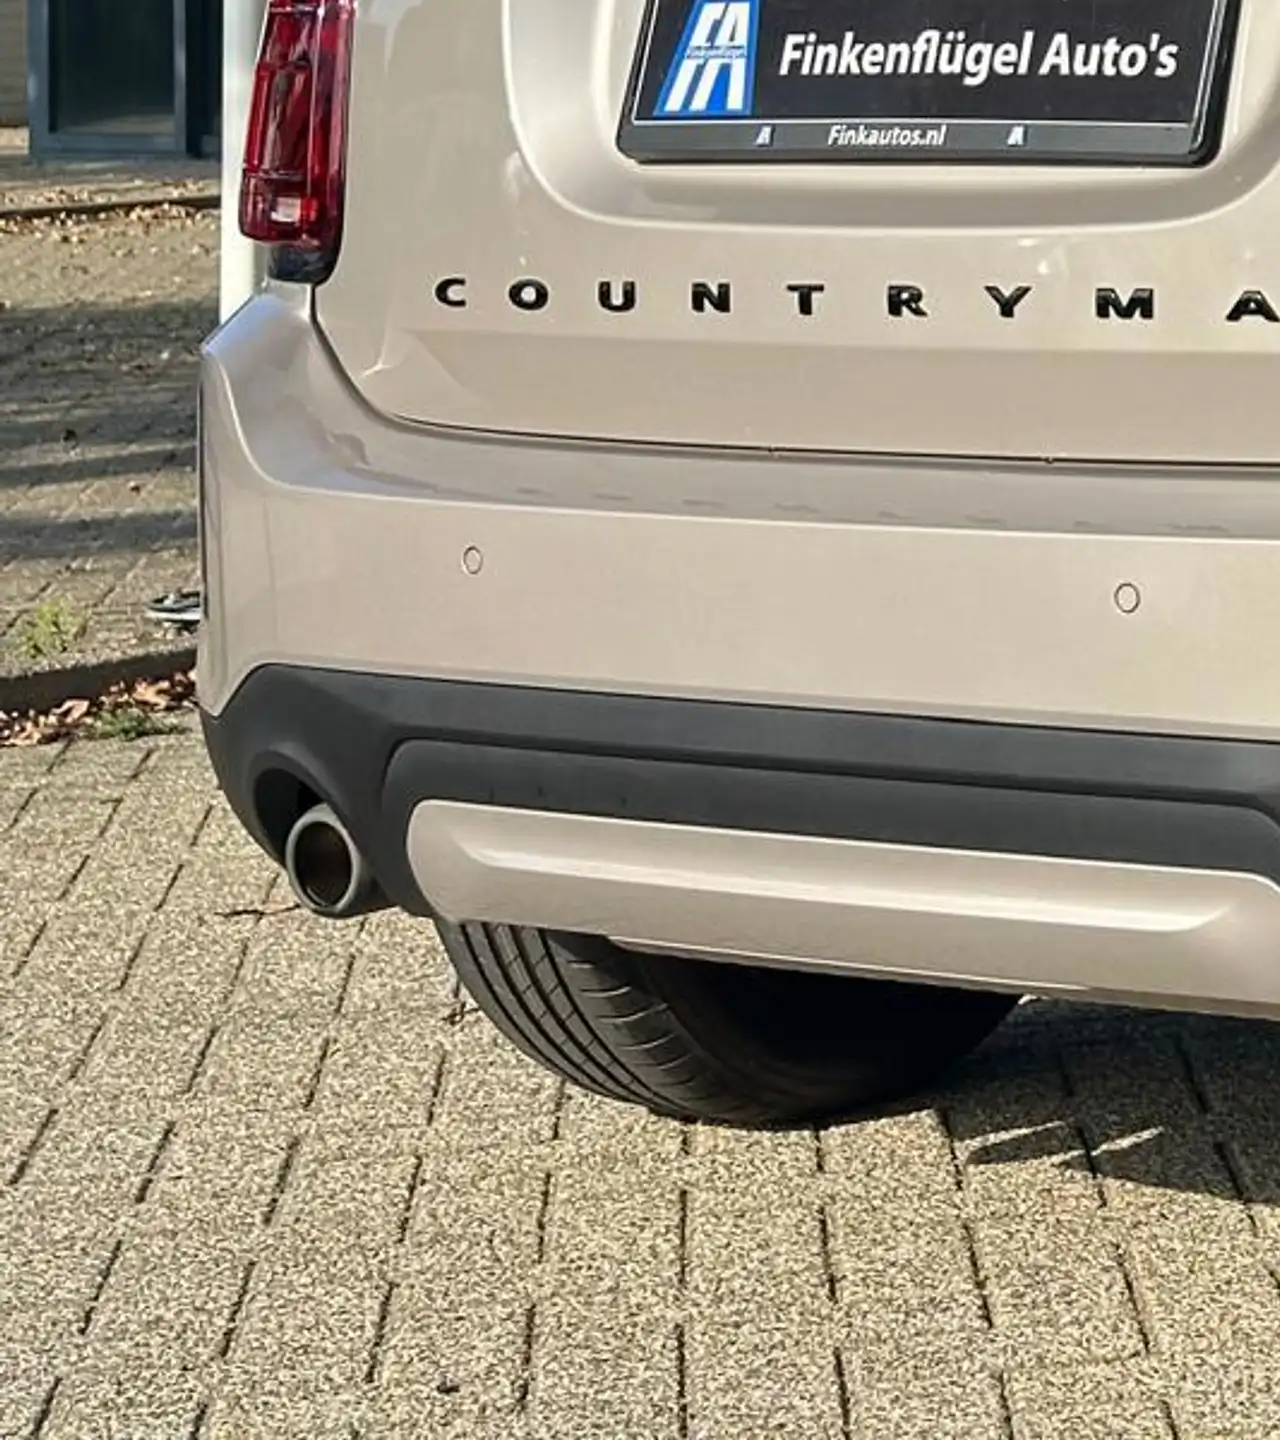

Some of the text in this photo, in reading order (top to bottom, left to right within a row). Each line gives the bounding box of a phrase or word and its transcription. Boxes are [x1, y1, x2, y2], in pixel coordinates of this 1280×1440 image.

[778, 29, 1180, 87] Finkenflügel Auto's
[827, 123, 949, 147] Finkautos.nl
